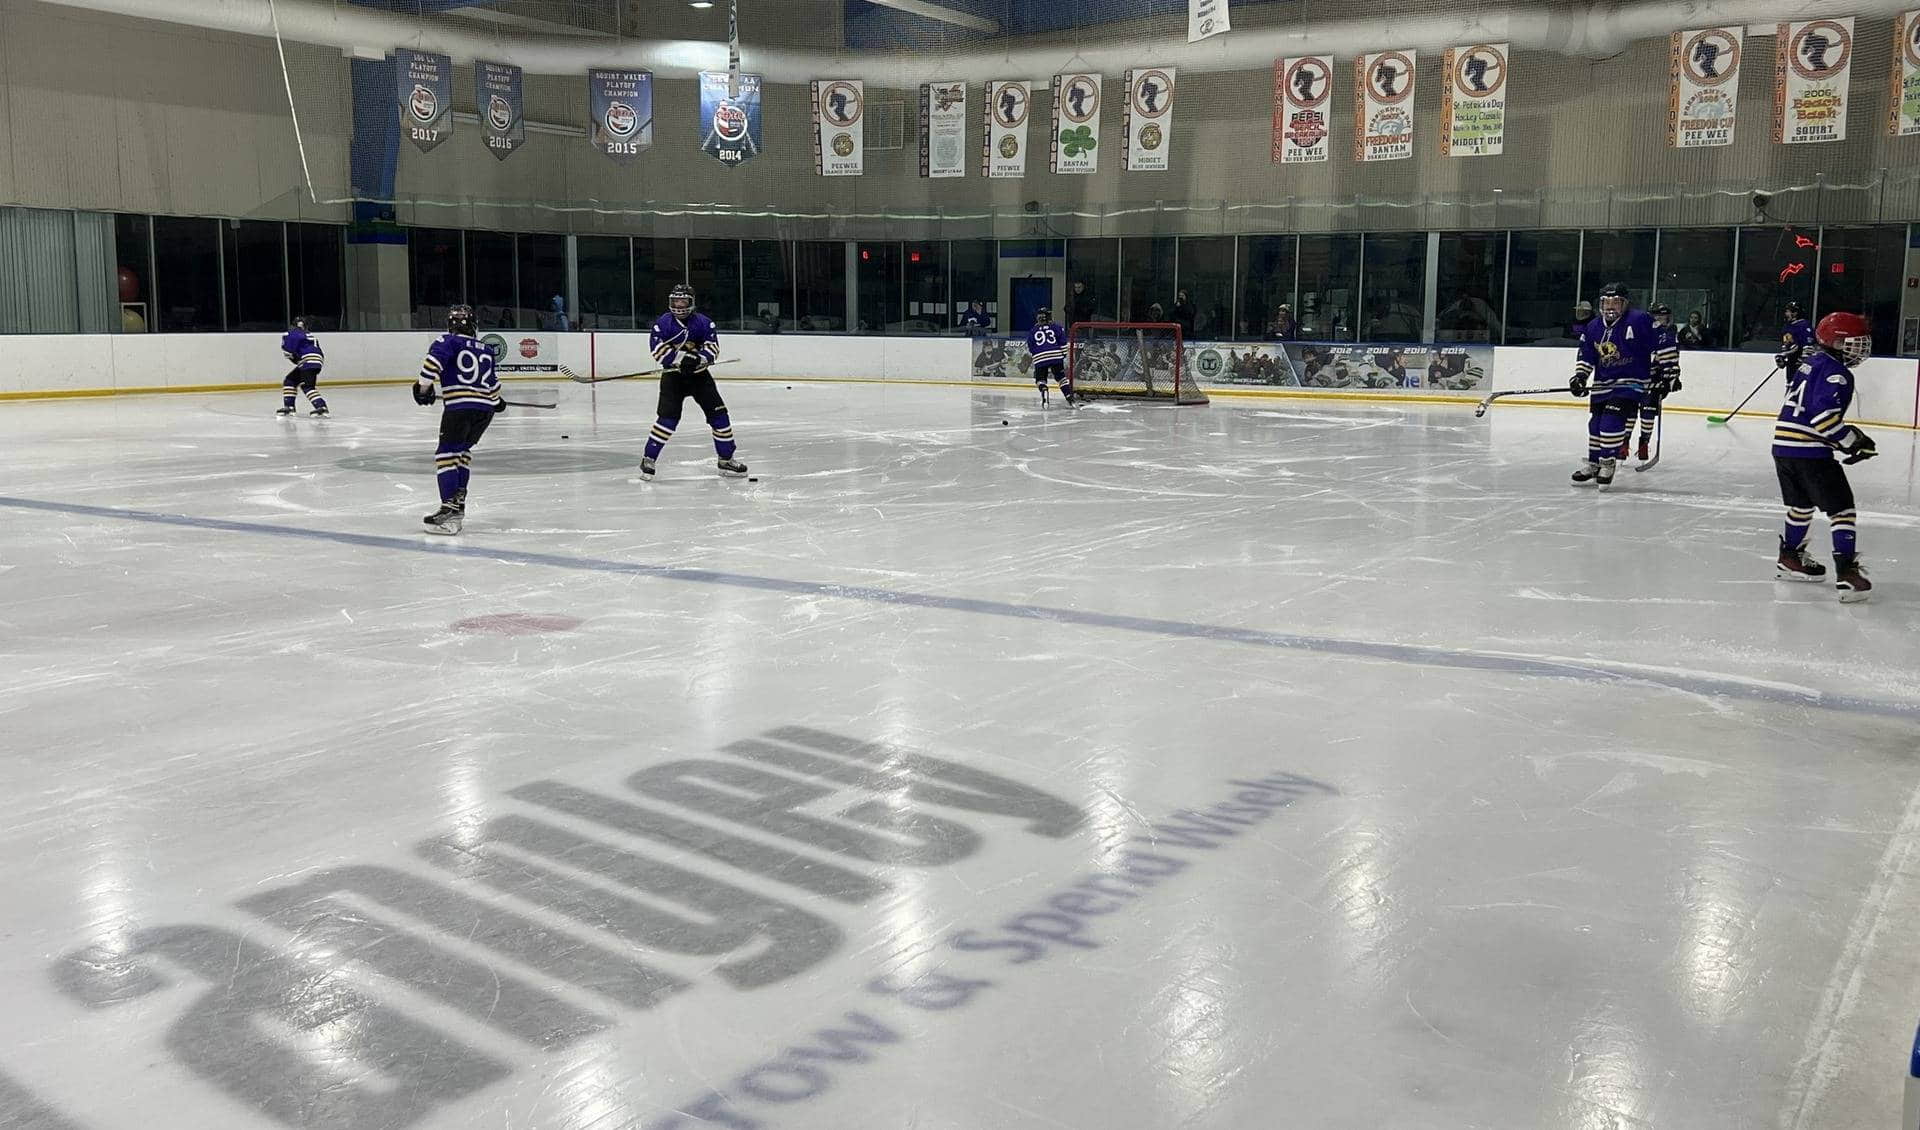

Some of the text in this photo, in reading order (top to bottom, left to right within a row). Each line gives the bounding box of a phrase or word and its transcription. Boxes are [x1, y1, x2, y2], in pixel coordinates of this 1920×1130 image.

[596, 72, 620, 81] SQUIRT
[606, 81, 636, 89] PLAYOFF
[1668, 32, 1680, 146] CHAMPIONS
[604, 89, 639, 98] CHAMPION
[1804, 89, 1832, 98] 2006
[1442, 48, 1453, 155] CHAMPIONS
[1491, 99, 1504, 110] Day
[1292, 111, 1323, 122] PEPSI
[1680, 118, 1718, 131] FREEDOM
[411, 127, 438, 142] 2017
[1685, 129, 1728, 139] PEE WEE
[1796, 125, 1834, 136] SQUIRT
[489, 136, 512, 149] 2016
[607, 142, 637, 154] 2015
[1452, 138, 1484, 147] MIDGET
[1288, 147, 1323, 156] PEE WEE
[1372, 144, 1406, 154] BANTAM
[719, 150, 742, 160] 2014
[1034, 329, 1057, 346] 93
[1625, 325, 1635, 340] A
[456, 349, 493, 388] 92
[866, 967, 995, 1012] &
[951, 848, 1194, 965] Spend
[1132, 770, 1341, 850] Wisely
[0, 724, 1090, 1130] angley
